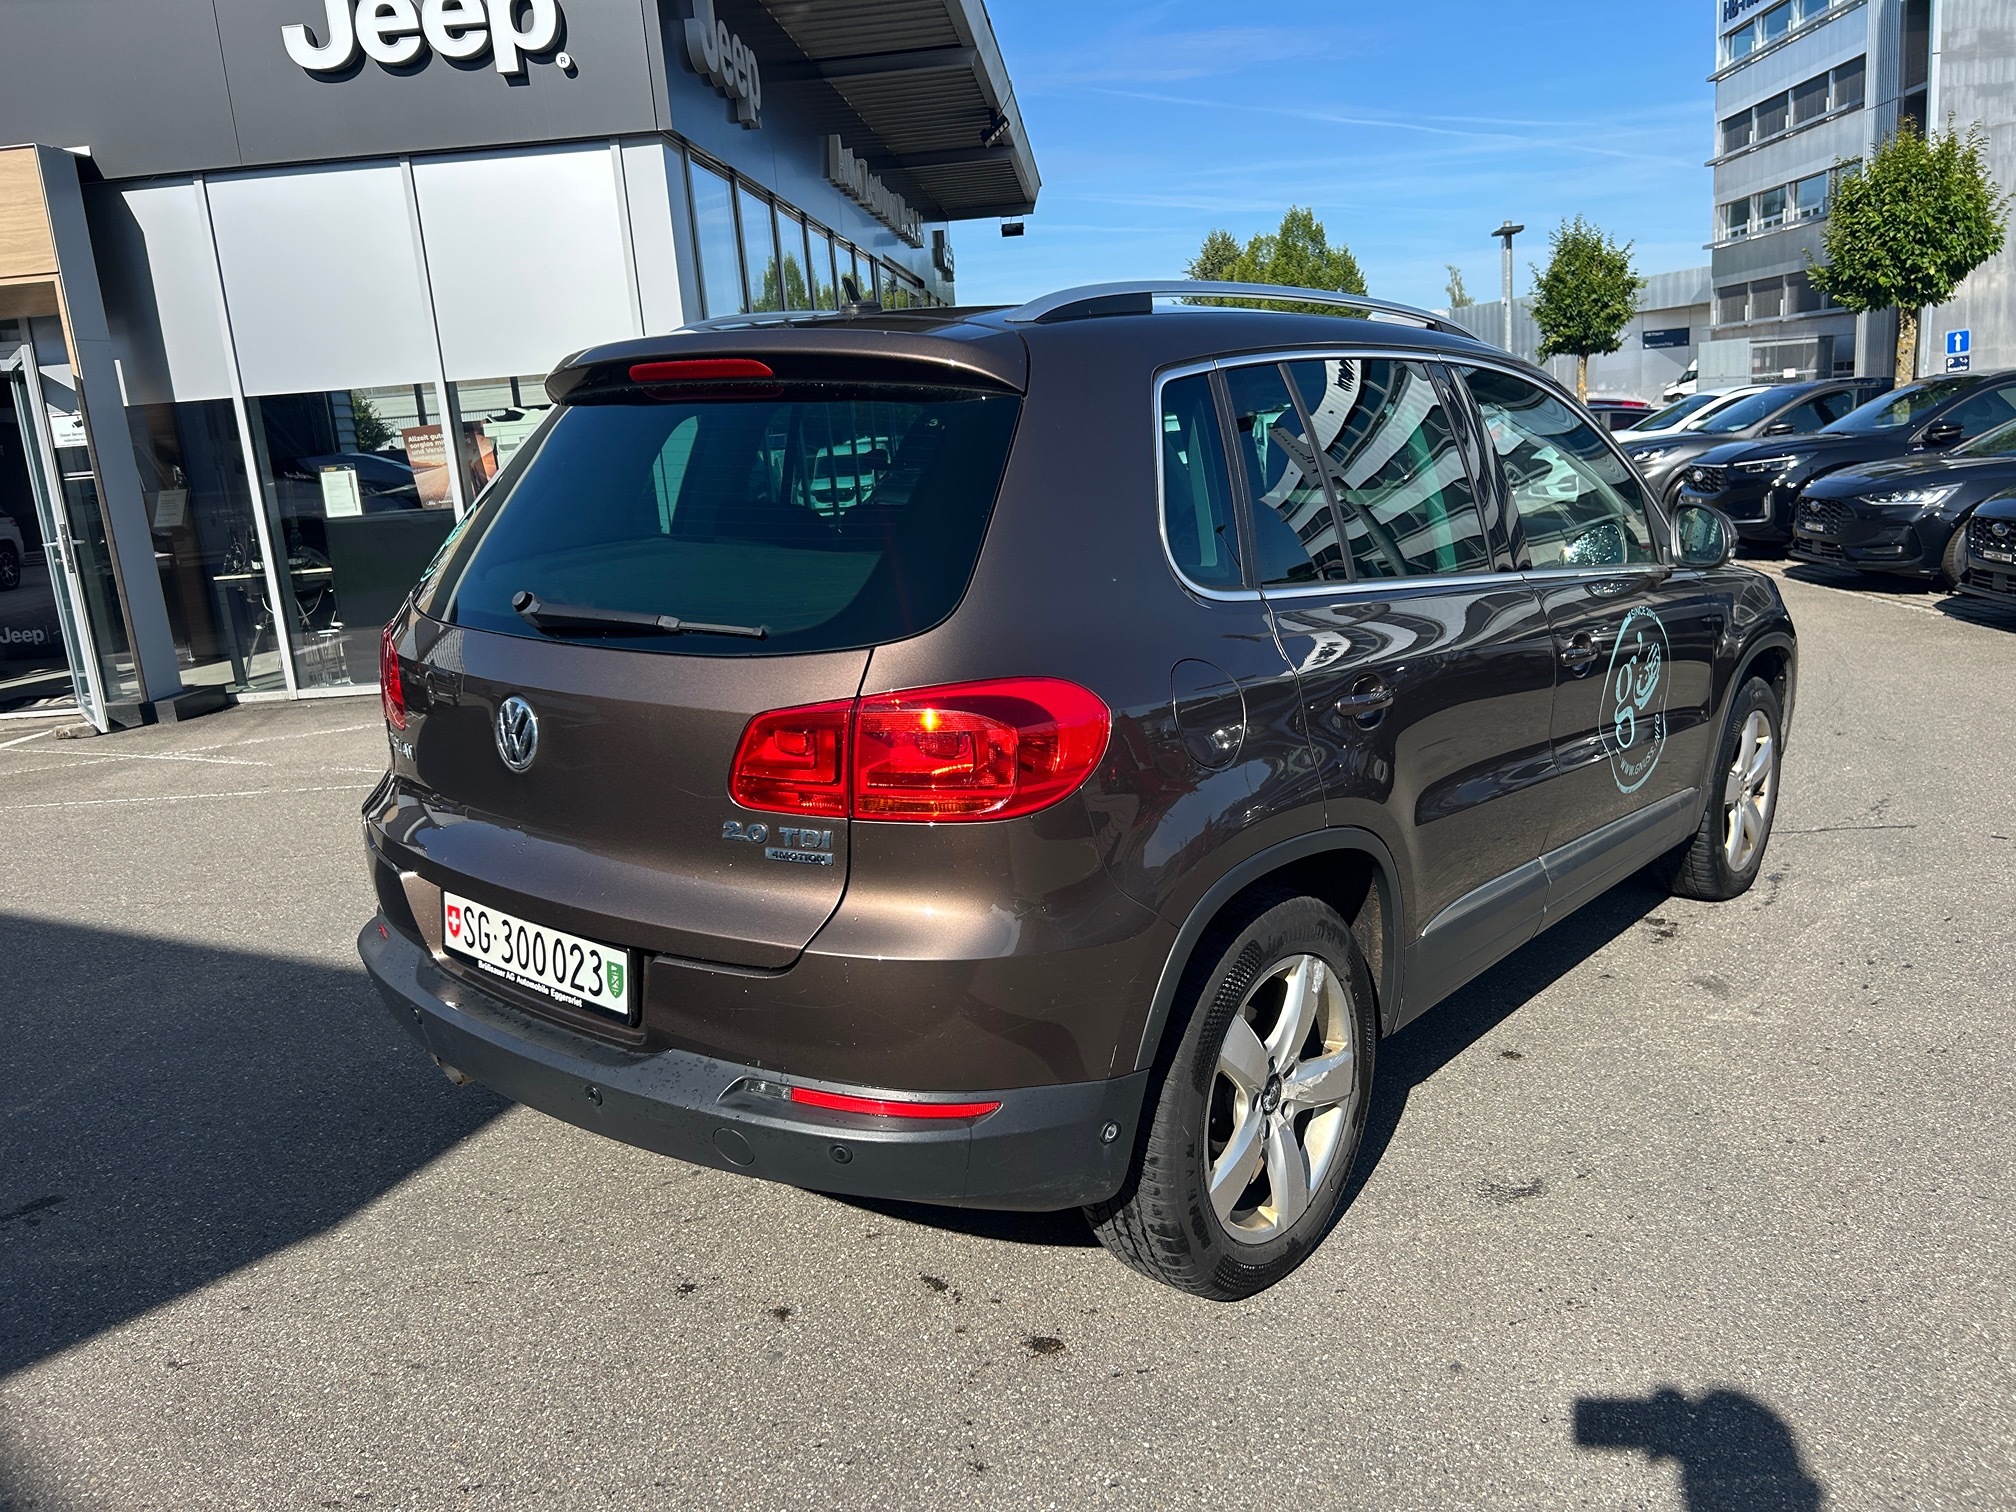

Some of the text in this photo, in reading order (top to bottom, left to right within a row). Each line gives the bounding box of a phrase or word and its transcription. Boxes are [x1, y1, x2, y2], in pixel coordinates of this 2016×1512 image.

[281, 0, 558, 73] Jeep
[684, 0, 761, 122] Jeep
[0, 626, 45, 645] Jeep
[779, 826, 832, 849] TDI
[772, 850, 826, 864] 4MOTION
[505, 971, 516, 982] AG
[516, 976, 549, 995] Automobile
